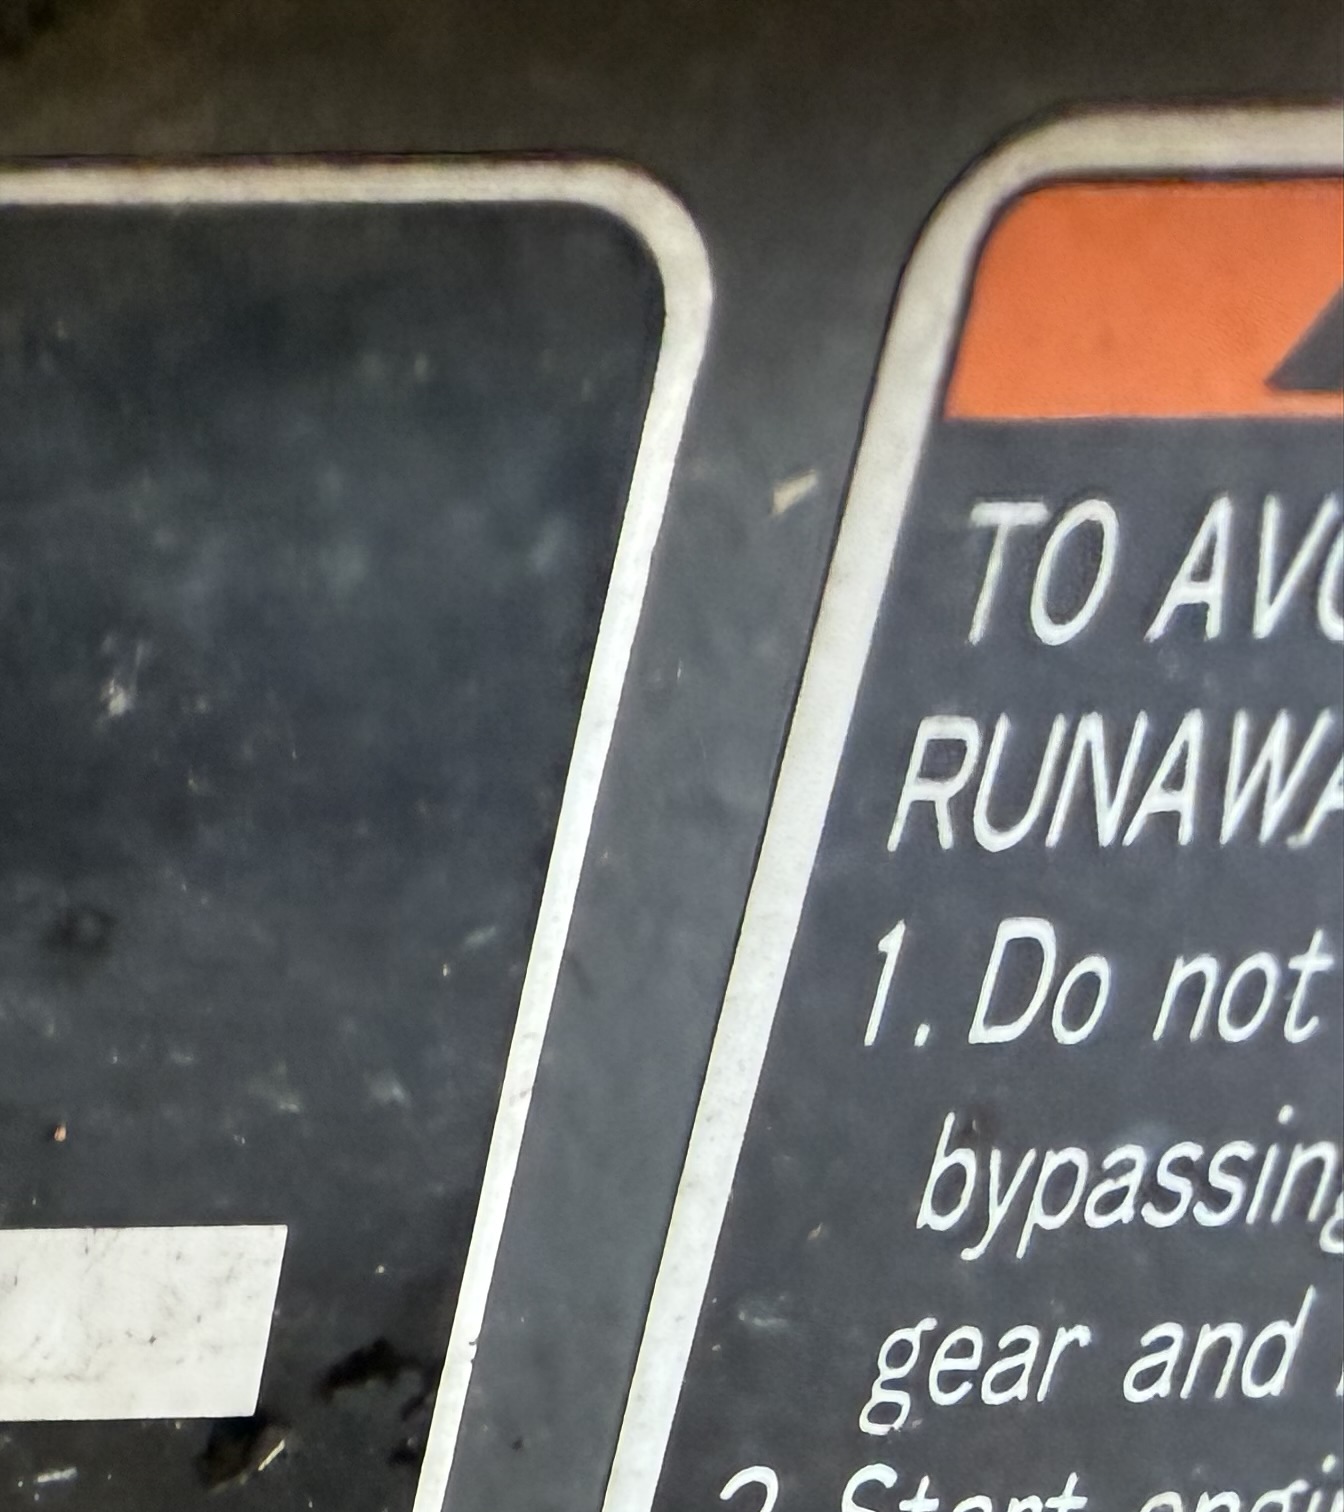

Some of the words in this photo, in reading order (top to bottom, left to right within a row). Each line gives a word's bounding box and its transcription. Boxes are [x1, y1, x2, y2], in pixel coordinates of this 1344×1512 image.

[969, 498, 1120, 646] TO
[864, 918, 931, 1047] 1.
[968, 916, 1112, 1045] Do
[1152, 928, 1334, 1044] not
[858, 1316, 1092, 1436] gear
[1123, 1285, 1317, 1403] and
